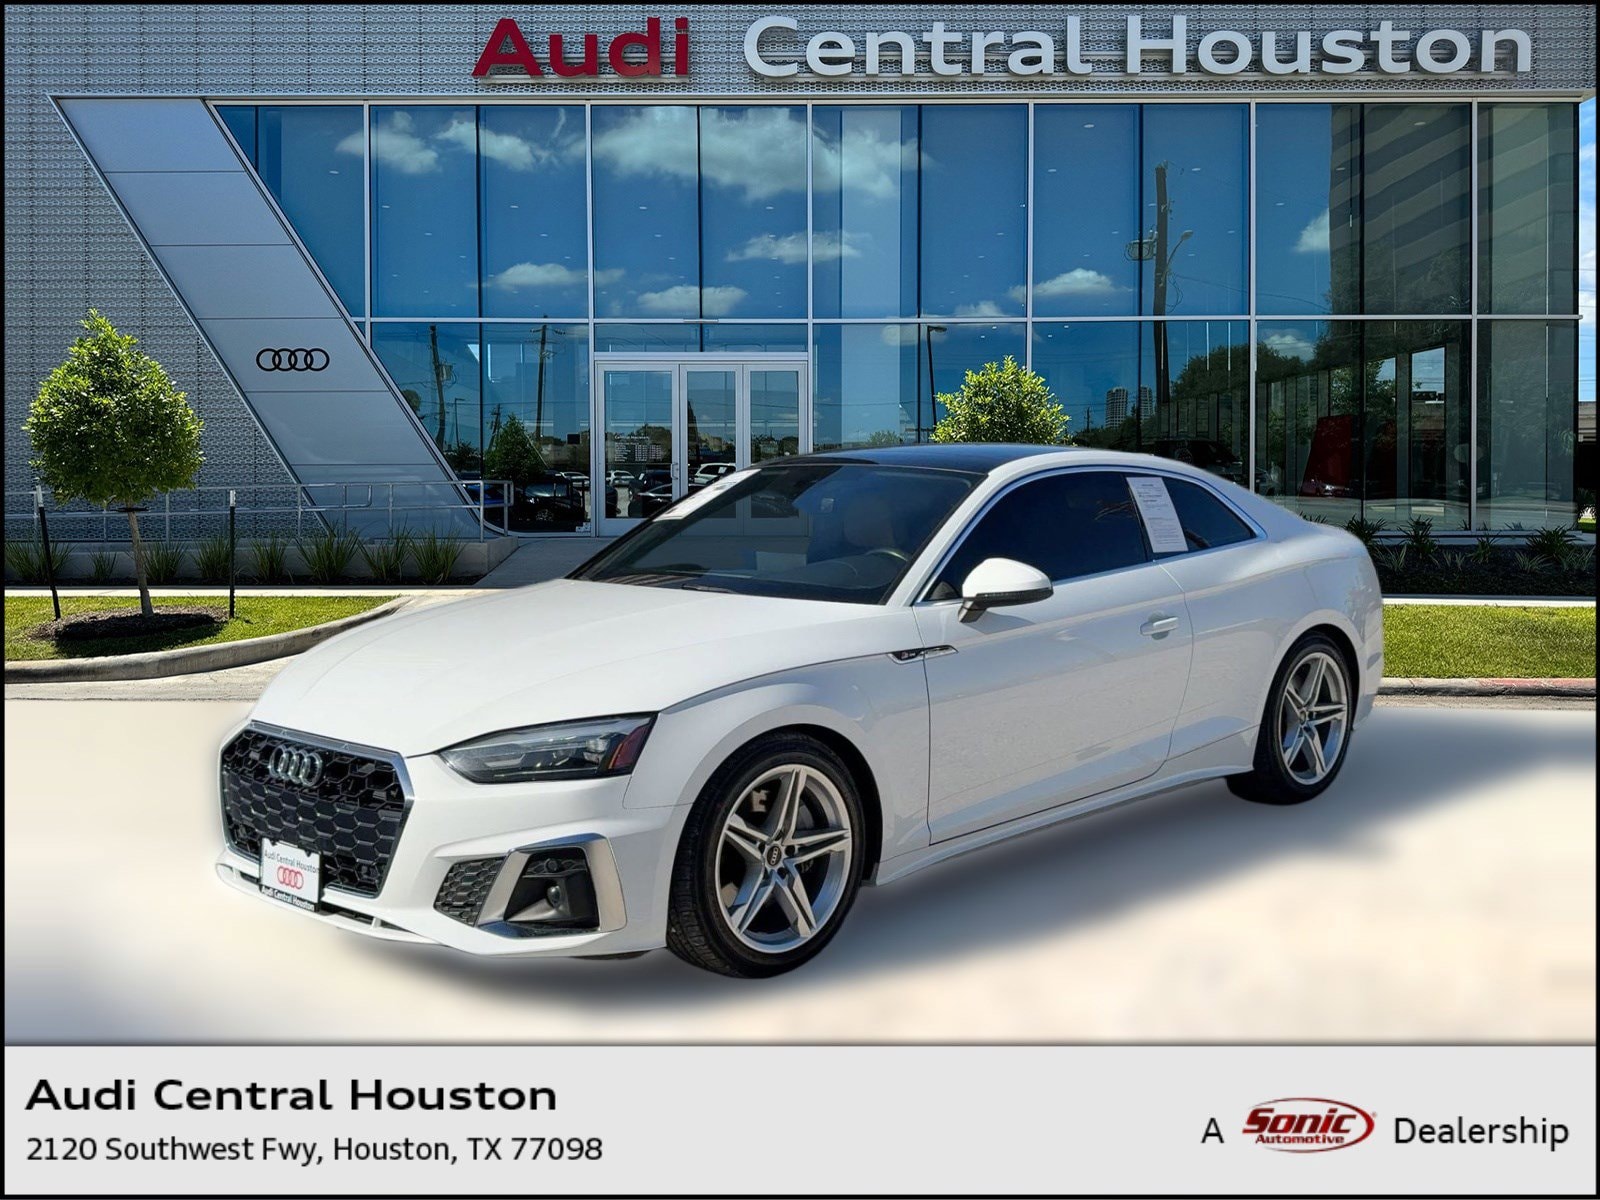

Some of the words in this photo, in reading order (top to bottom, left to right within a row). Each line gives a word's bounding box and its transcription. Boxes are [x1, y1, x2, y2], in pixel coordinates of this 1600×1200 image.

[473, 17, 690, 78] Audi
[744, 15, 1093, 77] Central
[1126, 15, 1532, 74] Houston
[276, 853, 296, 866] Central
